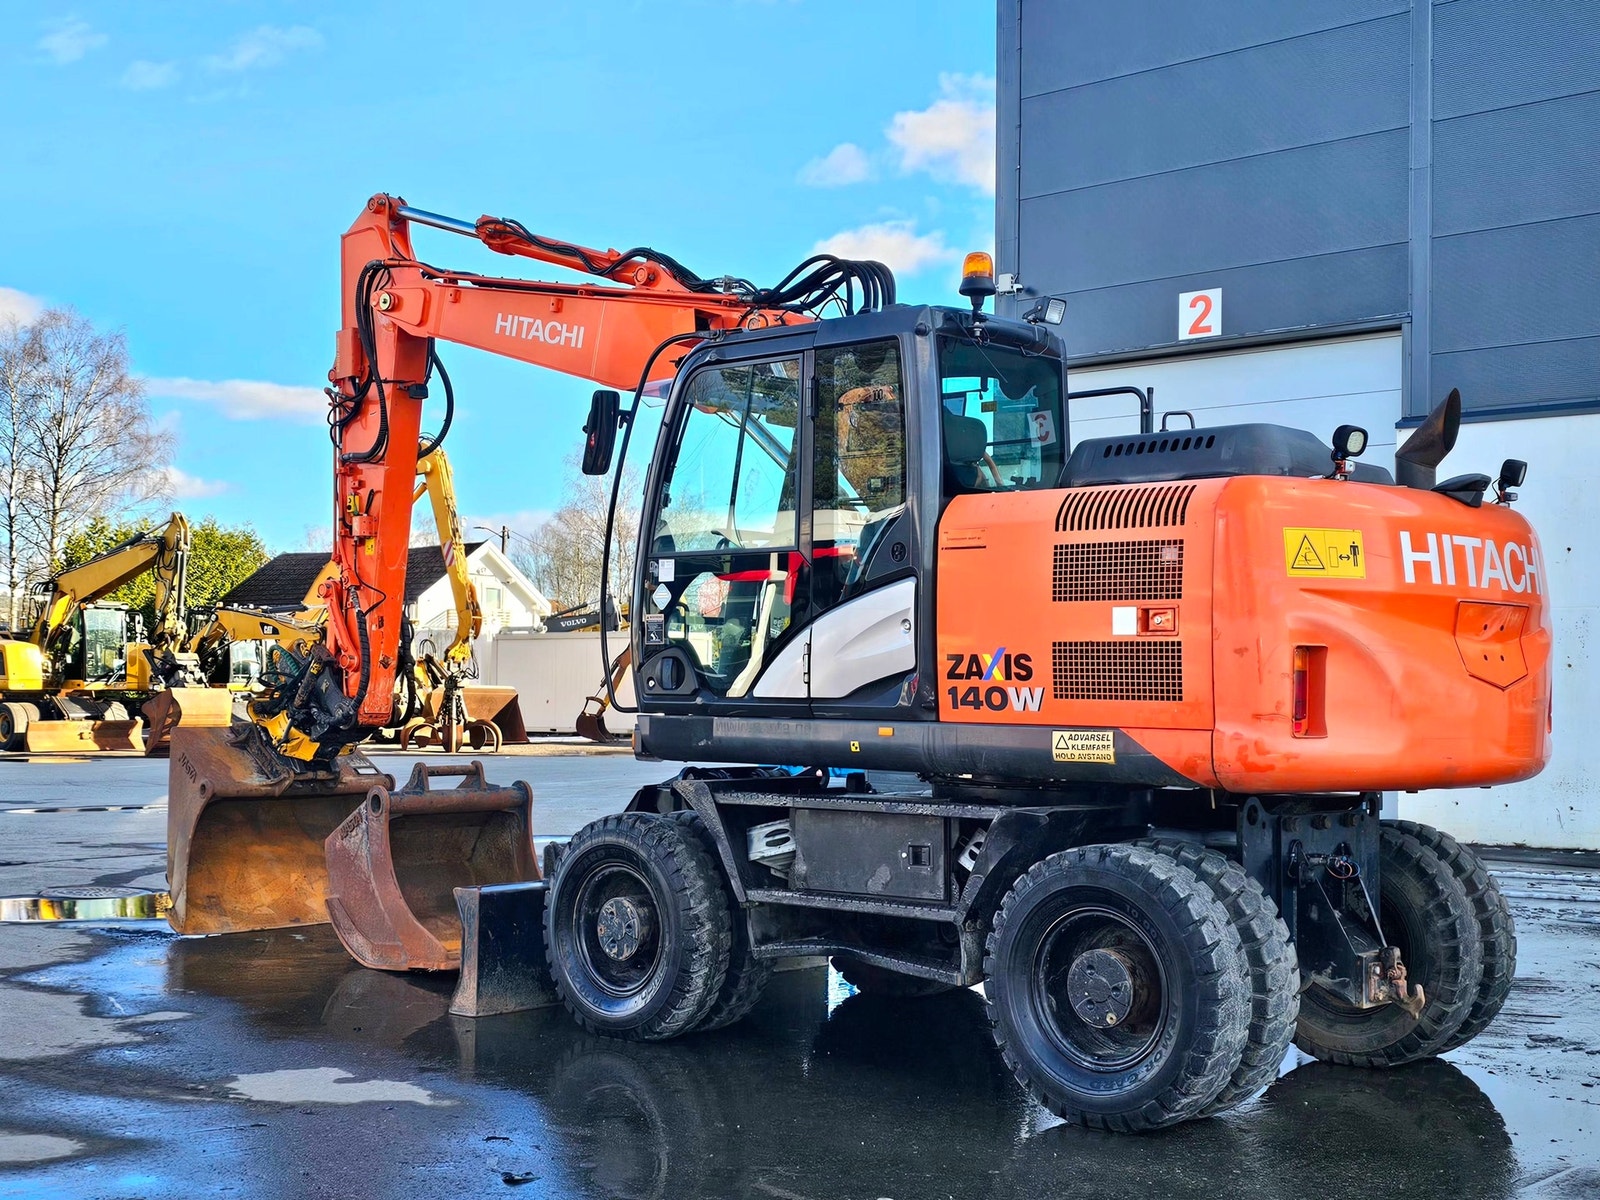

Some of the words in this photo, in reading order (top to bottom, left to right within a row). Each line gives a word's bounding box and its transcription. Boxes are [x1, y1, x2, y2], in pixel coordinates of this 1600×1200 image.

[1188, 294, 1213, 335] 2
[494, 312, 585, 349] HITACHI
[560, 617, 587, 628] VOLVO
[946, 647, 1033, 682] ZAXIS
[947, 685, 1045, 712] 140W
[1067, 733, 1112, 742] ADVARSEL
[1071, 743, 1112, 751] KLEMFARE
[1055, 752, 1076, 760] HOLD
[1077, 753, 1112, 761] AVSTAND
